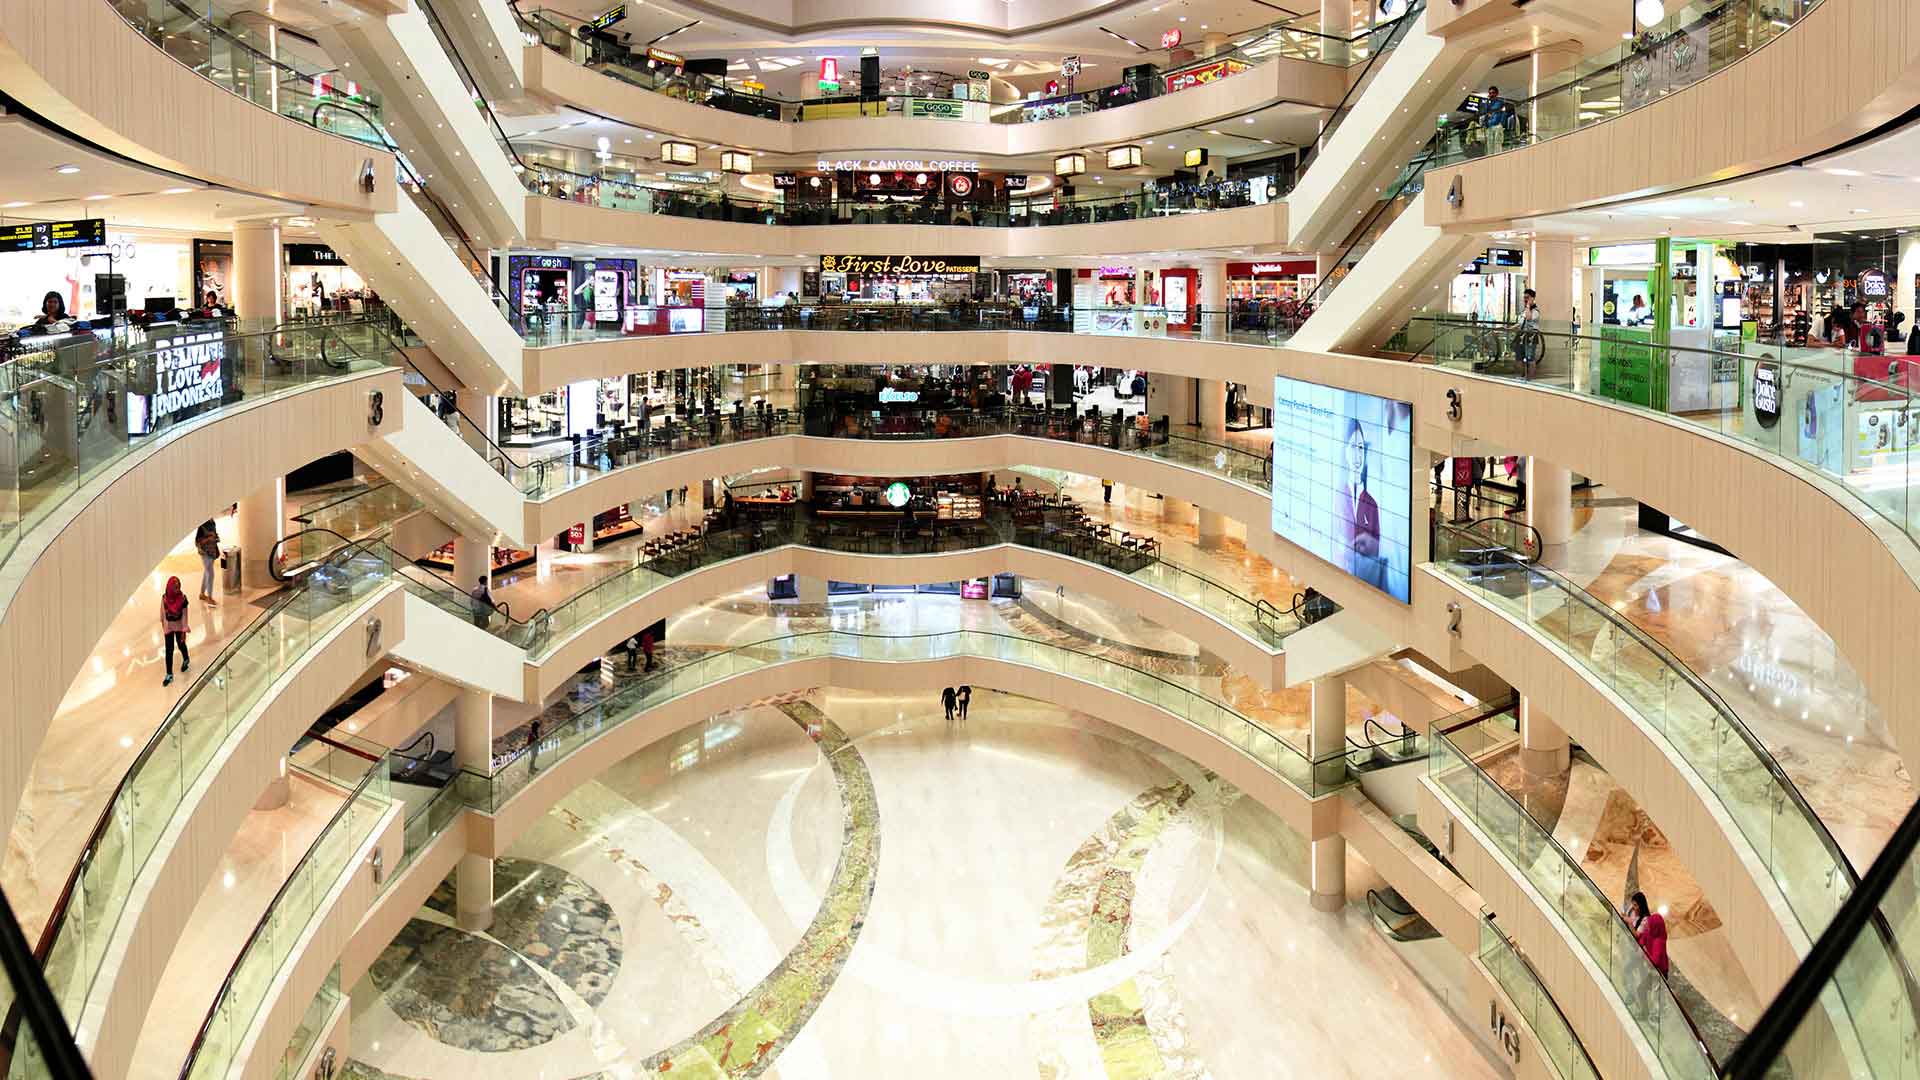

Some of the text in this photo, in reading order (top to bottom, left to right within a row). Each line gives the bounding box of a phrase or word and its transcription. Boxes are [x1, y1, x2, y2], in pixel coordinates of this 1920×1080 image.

[817, 160, 980, 172] BLACK CANYON COFFEE
[313, 250, 334, 260] THE
[837, 255, 892, 273] First
[892, 255, 946, 273] Love
[168, 365, 202, 392] LOVE
[157, 379, 224, 417] INDONESIA
[1755, 379, 1776, 400] Dolce
[368, 390, 384, 426] 3
[1446, 388, 1462, 422] 3
[1755, 395, 1776, 413] Gusto
